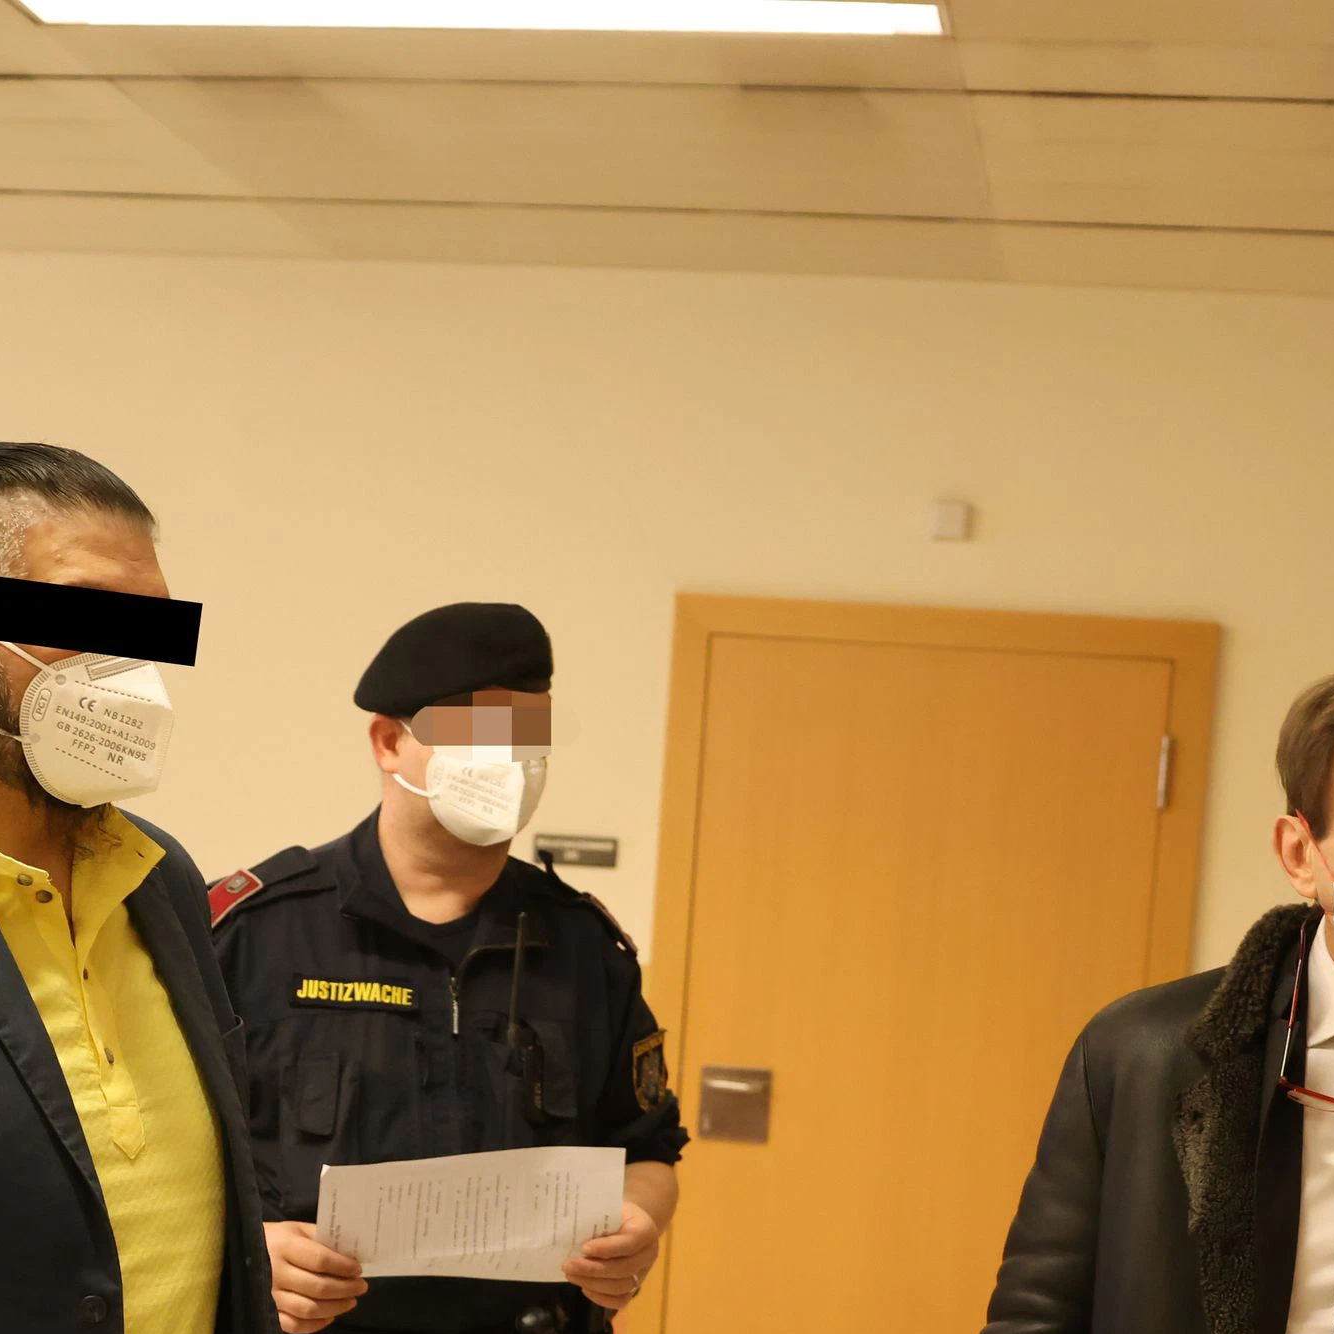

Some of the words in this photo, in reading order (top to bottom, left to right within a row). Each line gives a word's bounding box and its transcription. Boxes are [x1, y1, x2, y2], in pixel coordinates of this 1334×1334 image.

[36, 695, 47, 716] PGT
[56, 721, 71, 733] GB
[103, 708, 118, 720] NB
[119, 714, 144, 730] 1282
[71, 739, 97, 755] FFP2
[107, 752, 124, 766] NR
[296, 979, 413, 1006] JUSTIZWACHE
